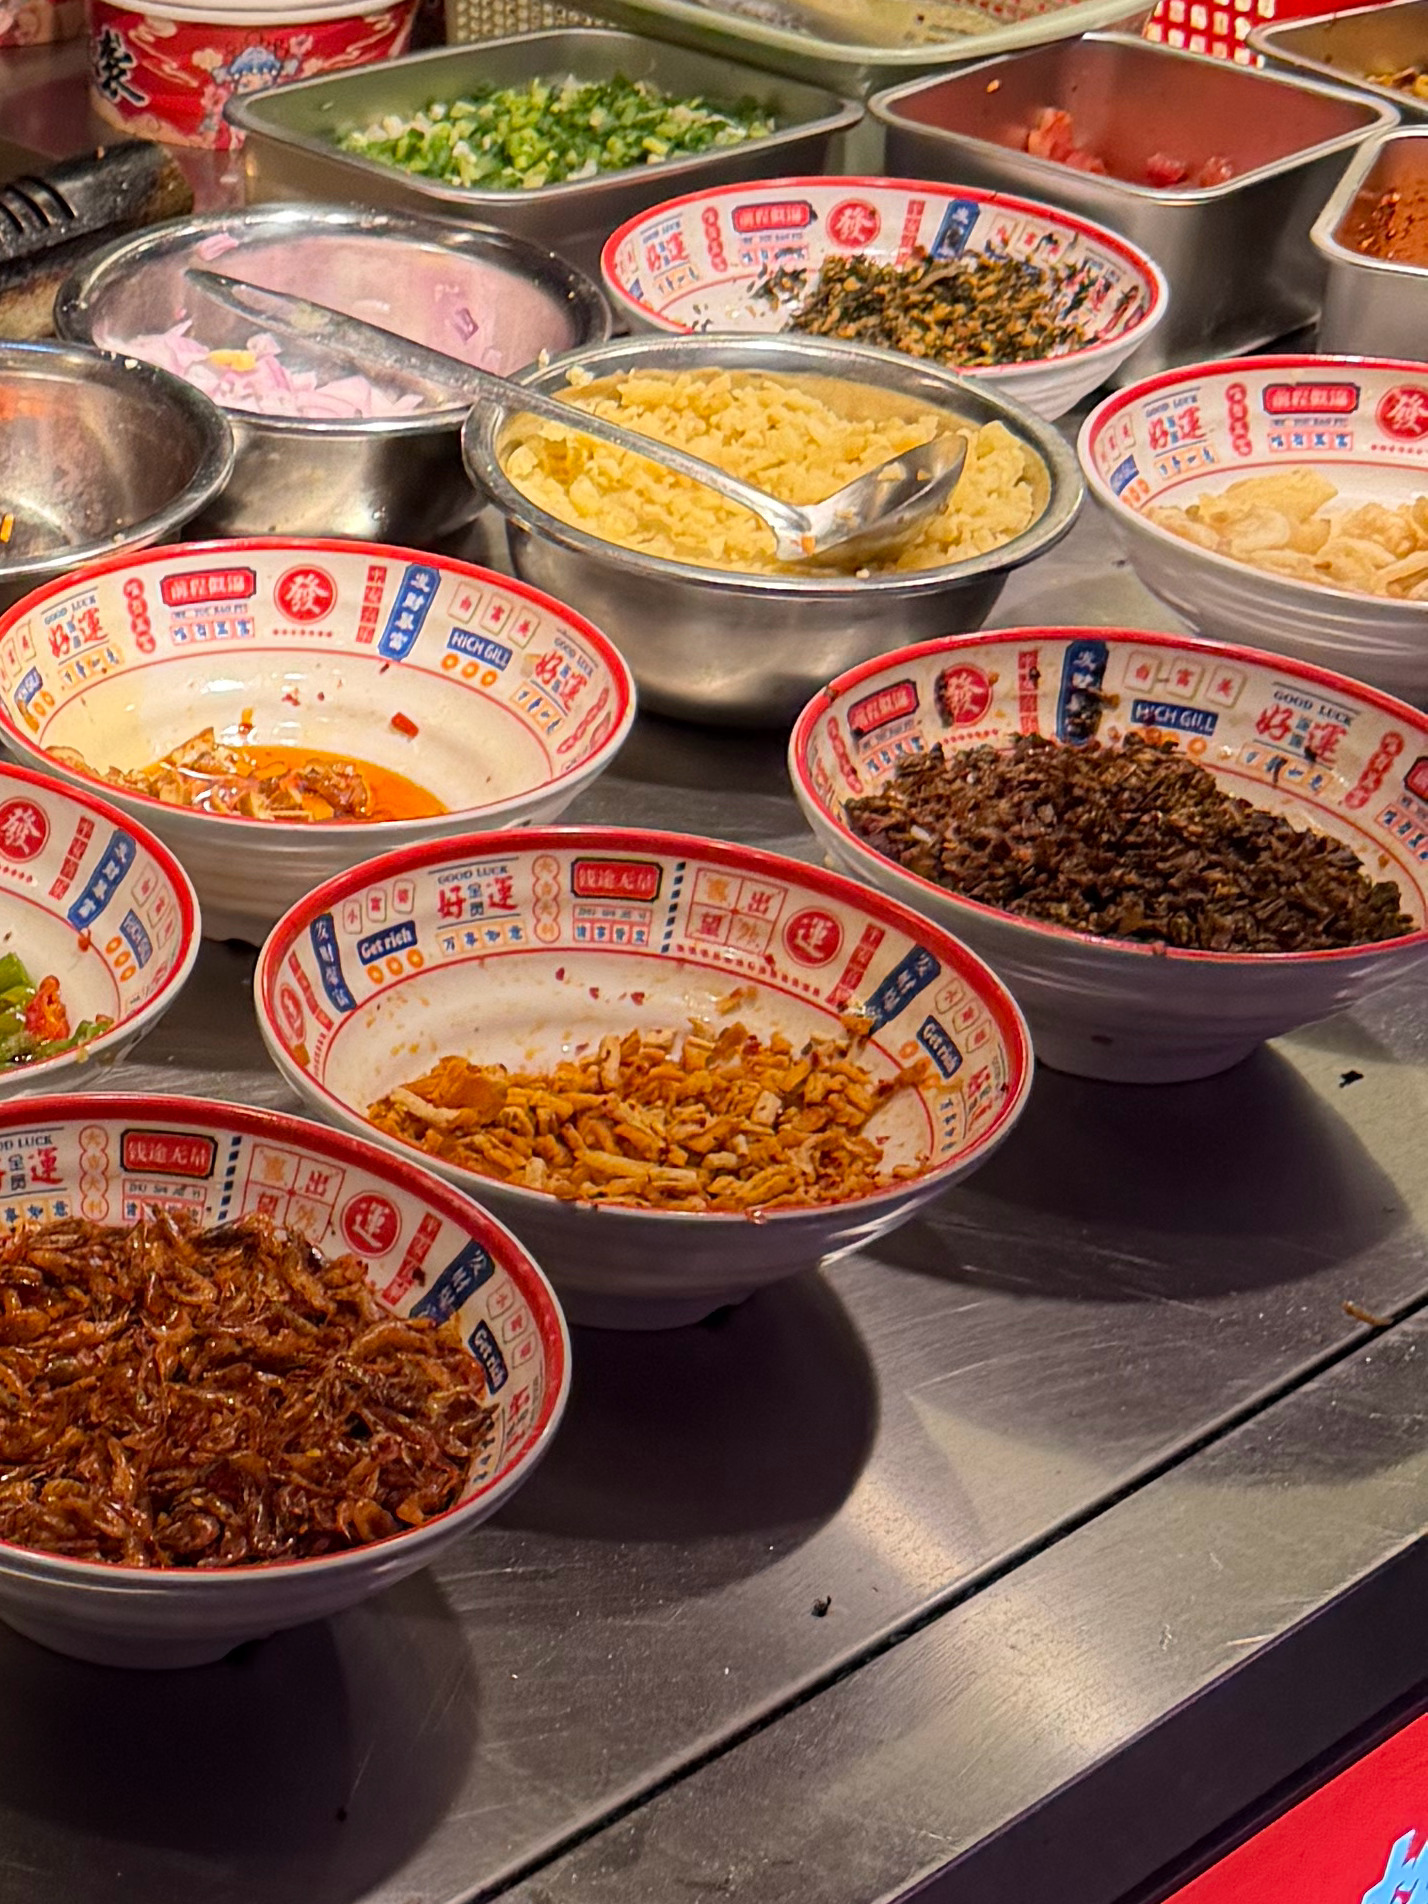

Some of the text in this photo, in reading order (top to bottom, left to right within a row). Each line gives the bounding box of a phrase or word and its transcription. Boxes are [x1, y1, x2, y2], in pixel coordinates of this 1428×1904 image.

[290, 573, 330, 614] 發
[1, 806, 42, 855] 發
[18, 1134, 53, 1149] LUCK
